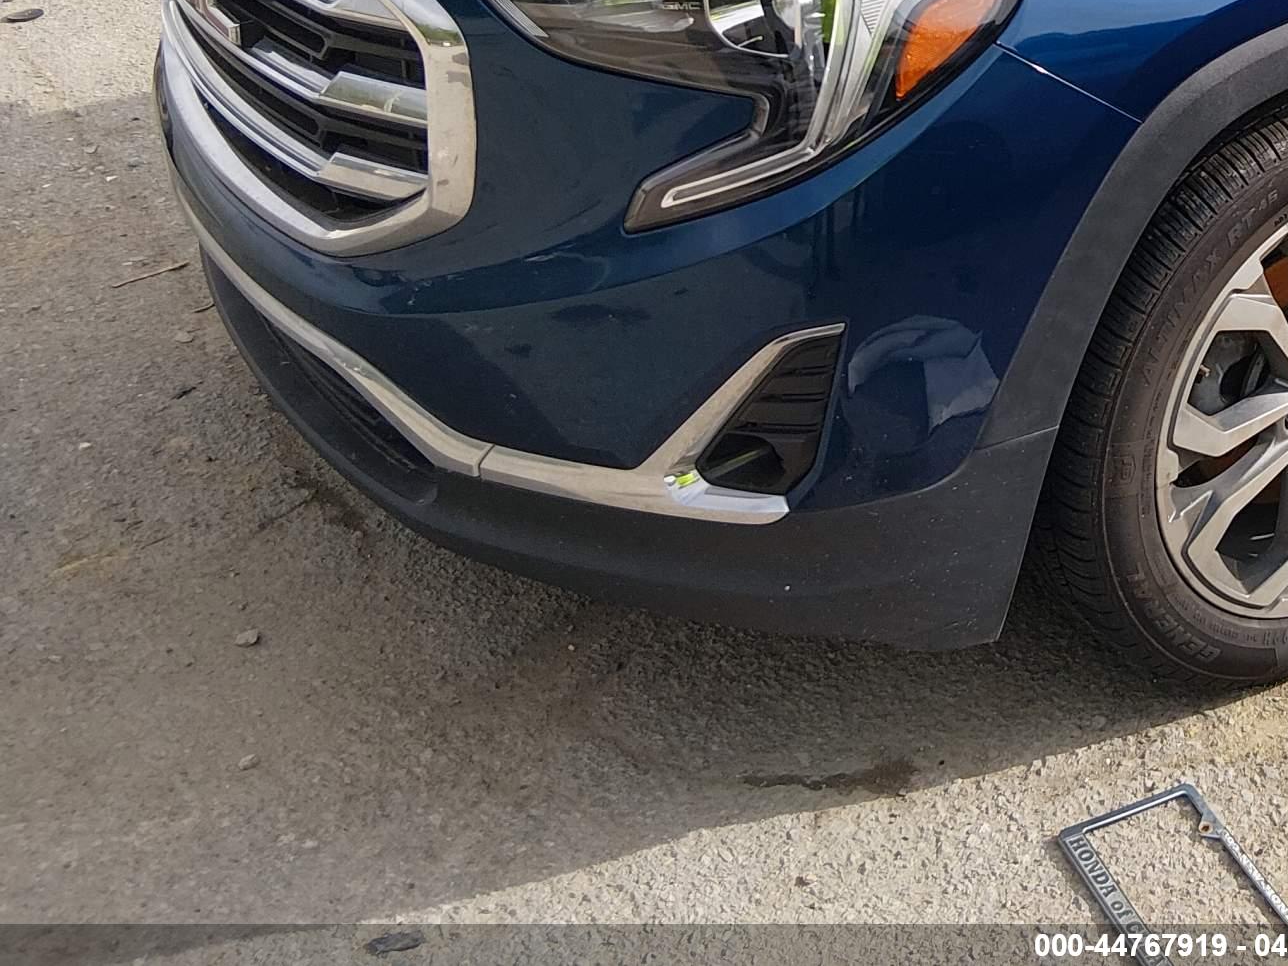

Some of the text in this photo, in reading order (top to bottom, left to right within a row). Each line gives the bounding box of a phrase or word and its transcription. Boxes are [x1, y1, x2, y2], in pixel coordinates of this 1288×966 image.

[663, 1, 701, 11] GMC
[1126, 561, 1220, 662] GENERAL
[1068, 837, 1134, 918] HONDA of
